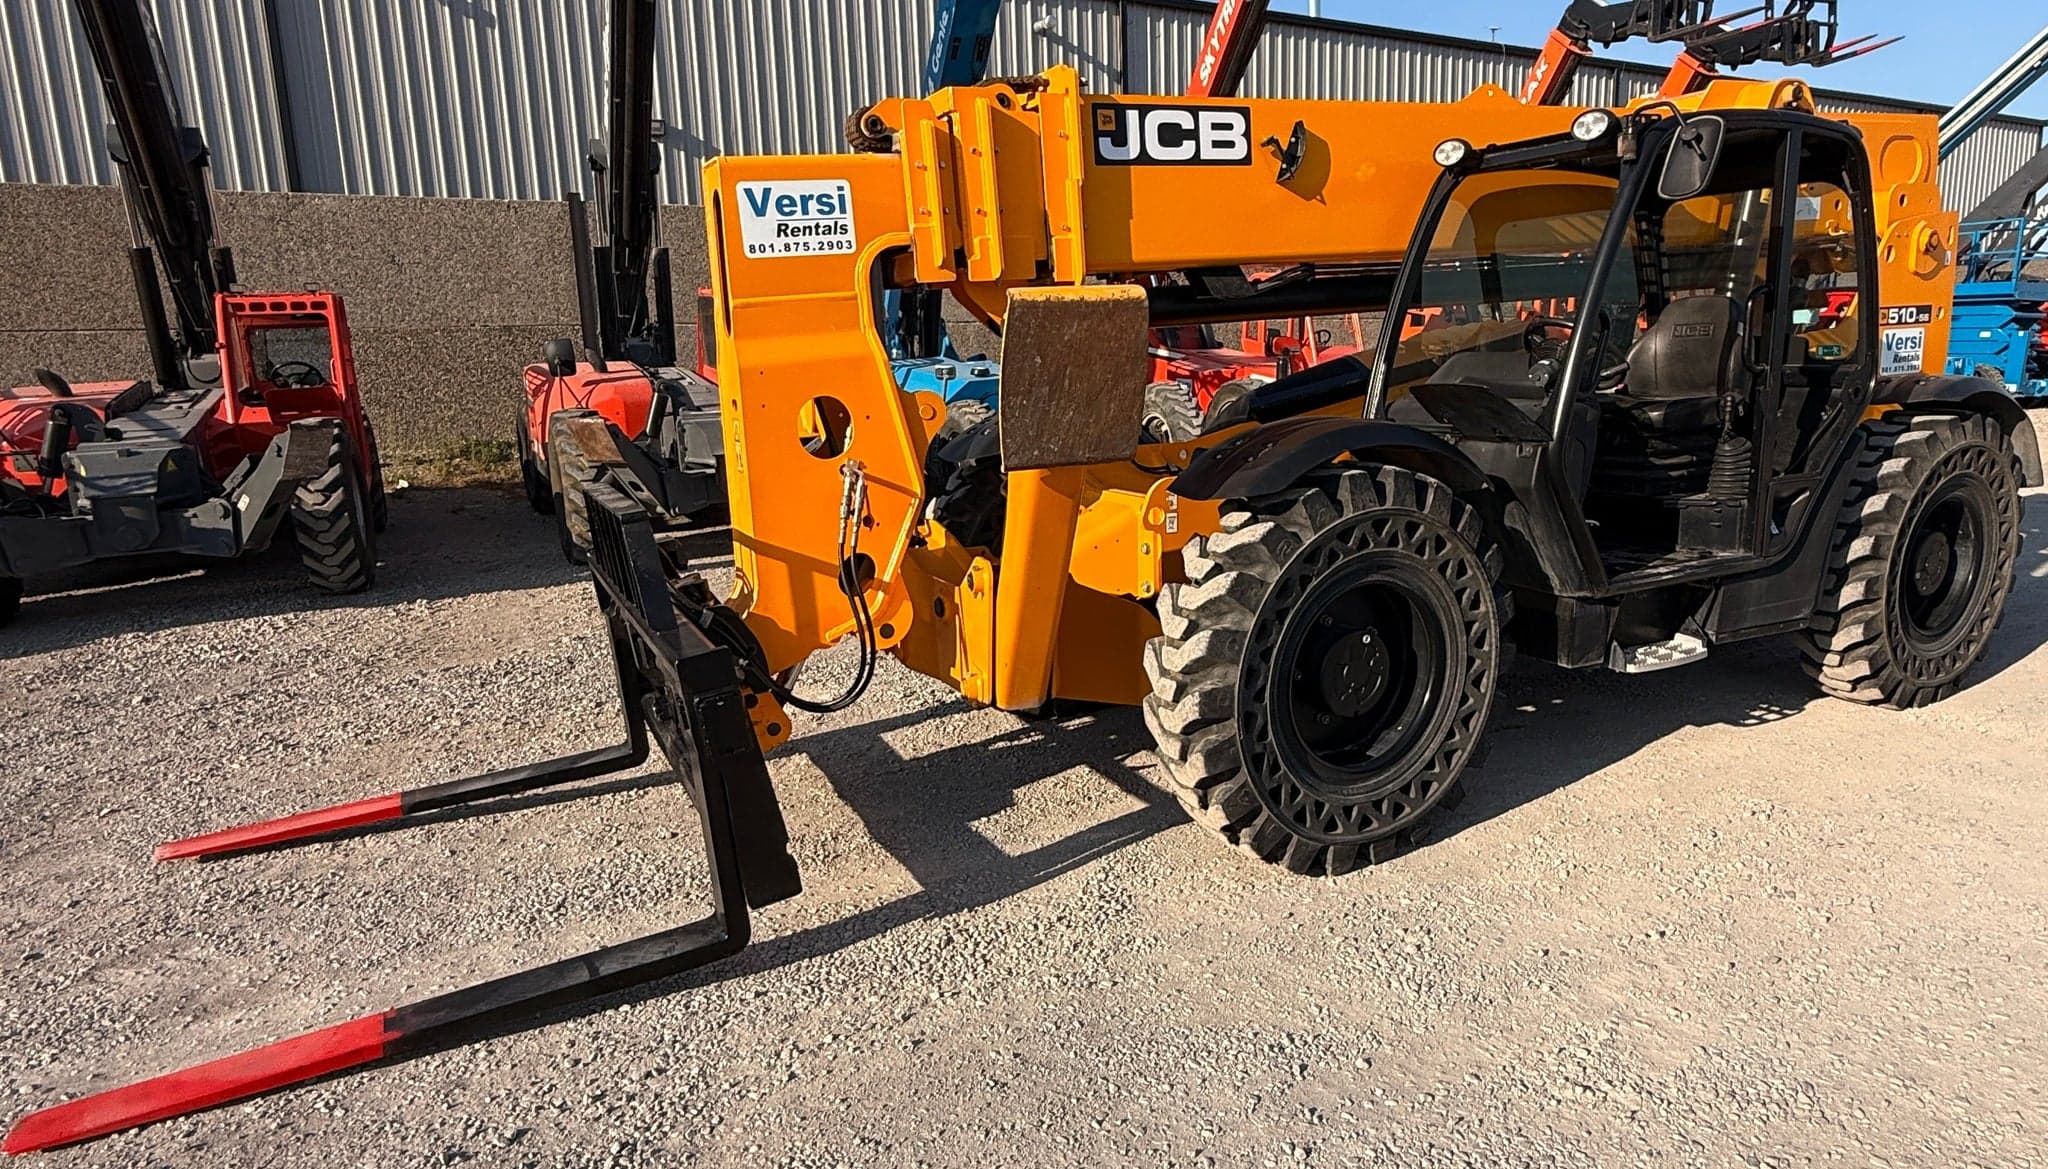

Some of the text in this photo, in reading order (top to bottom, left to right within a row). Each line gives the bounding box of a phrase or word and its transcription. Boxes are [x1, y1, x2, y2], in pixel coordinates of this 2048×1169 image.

[931, 10, 949, 73] Genie
[1520, 57, 1549, 105] AK
[1098, 109, 1249, 161] JCB
[743, 185, 848, 218] Versi
[776, 220, 849, 239] Rentals
[748, 239, 853, 255] 801.875.2903
[1885, 331, 1922, 351] Versi
